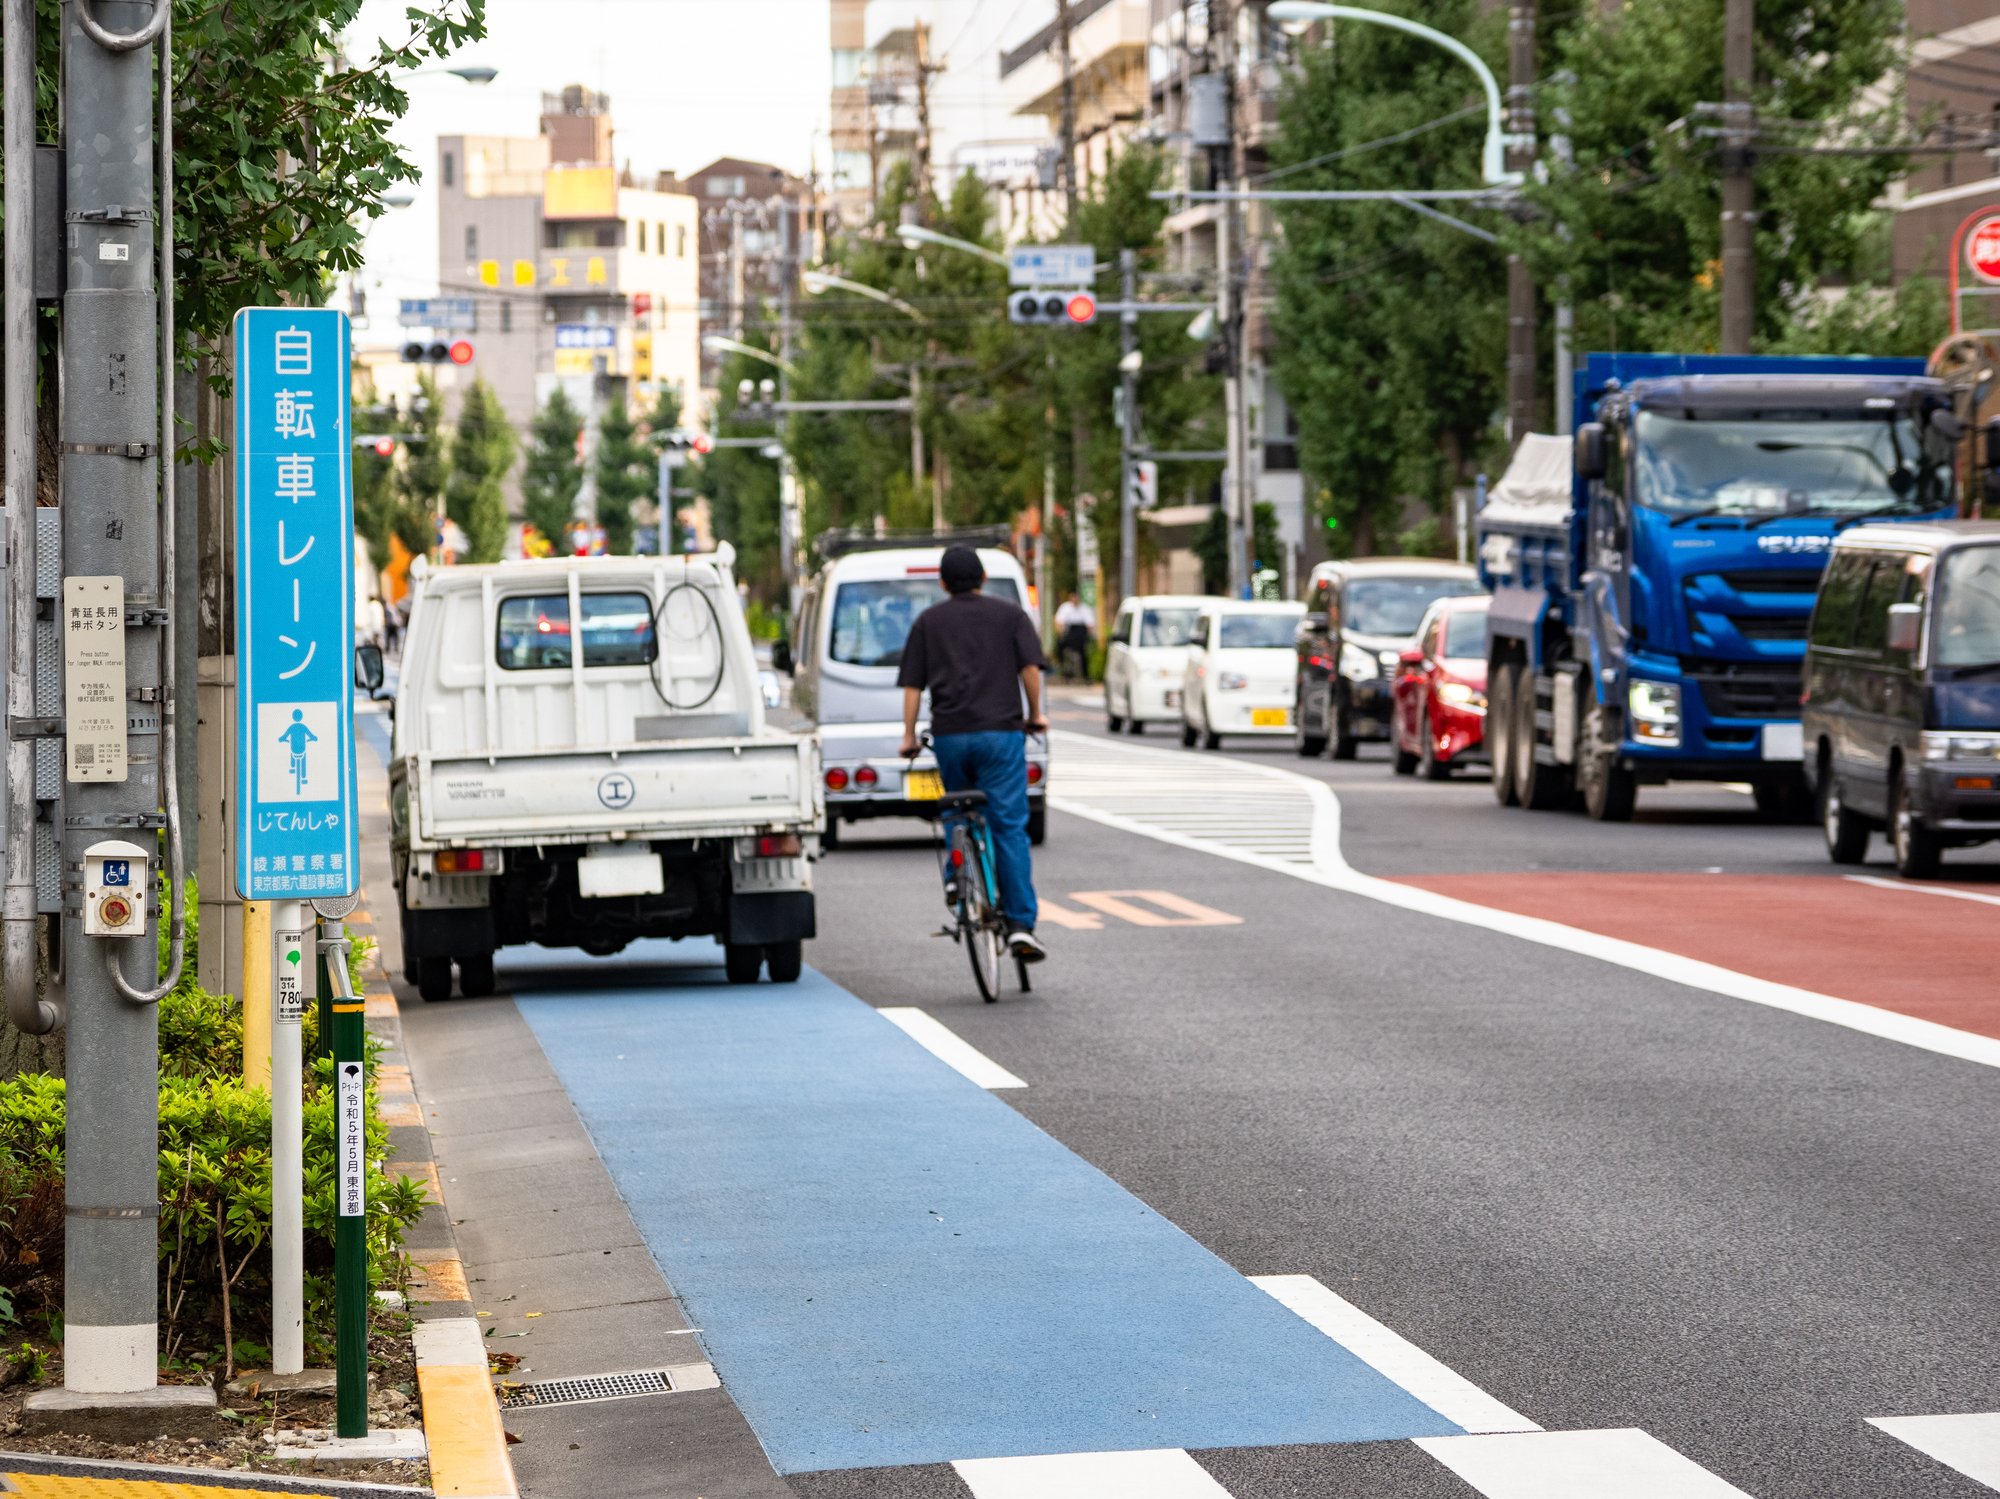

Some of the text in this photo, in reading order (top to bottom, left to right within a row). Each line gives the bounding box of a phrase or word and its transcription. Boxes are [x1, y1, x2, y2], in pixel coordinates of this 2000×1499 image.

[274, 325, 316, 679] 自転車レーン
[70, 607, 117, 618] 青延長用
[71, 620, 118, 631] 押ボタン
[253, 854, 343, 872] 綾瀬警察署
[253, 874, 344, 892] 東京都第六建設事務所
[280, 991, 302, 1005] 780
[346, 1176, 359, 1214] 東京都
